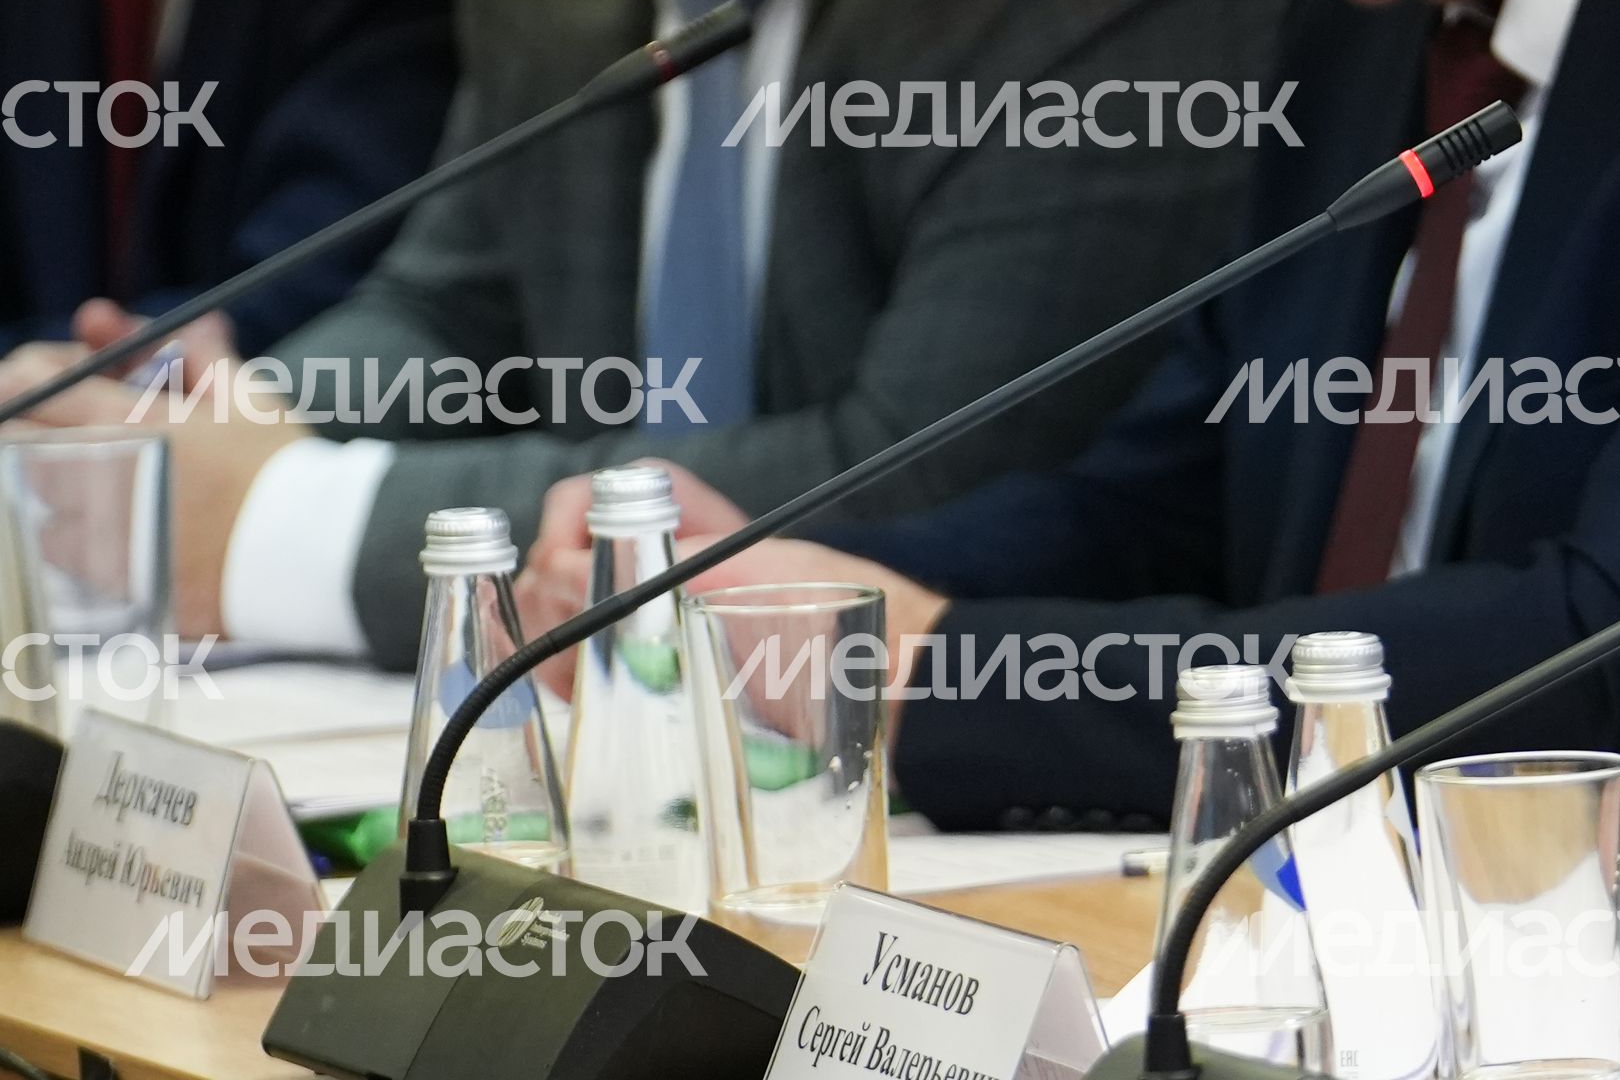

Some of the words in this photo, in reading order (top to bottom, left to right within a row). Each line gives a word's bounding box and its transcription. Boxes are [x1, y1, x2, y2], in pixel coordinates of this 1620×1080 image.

[93, 751, 199, 827] Деркачев
[862, 931, 980, 1015] Усманов
[797, 1005, 870, 1068] Сергей
